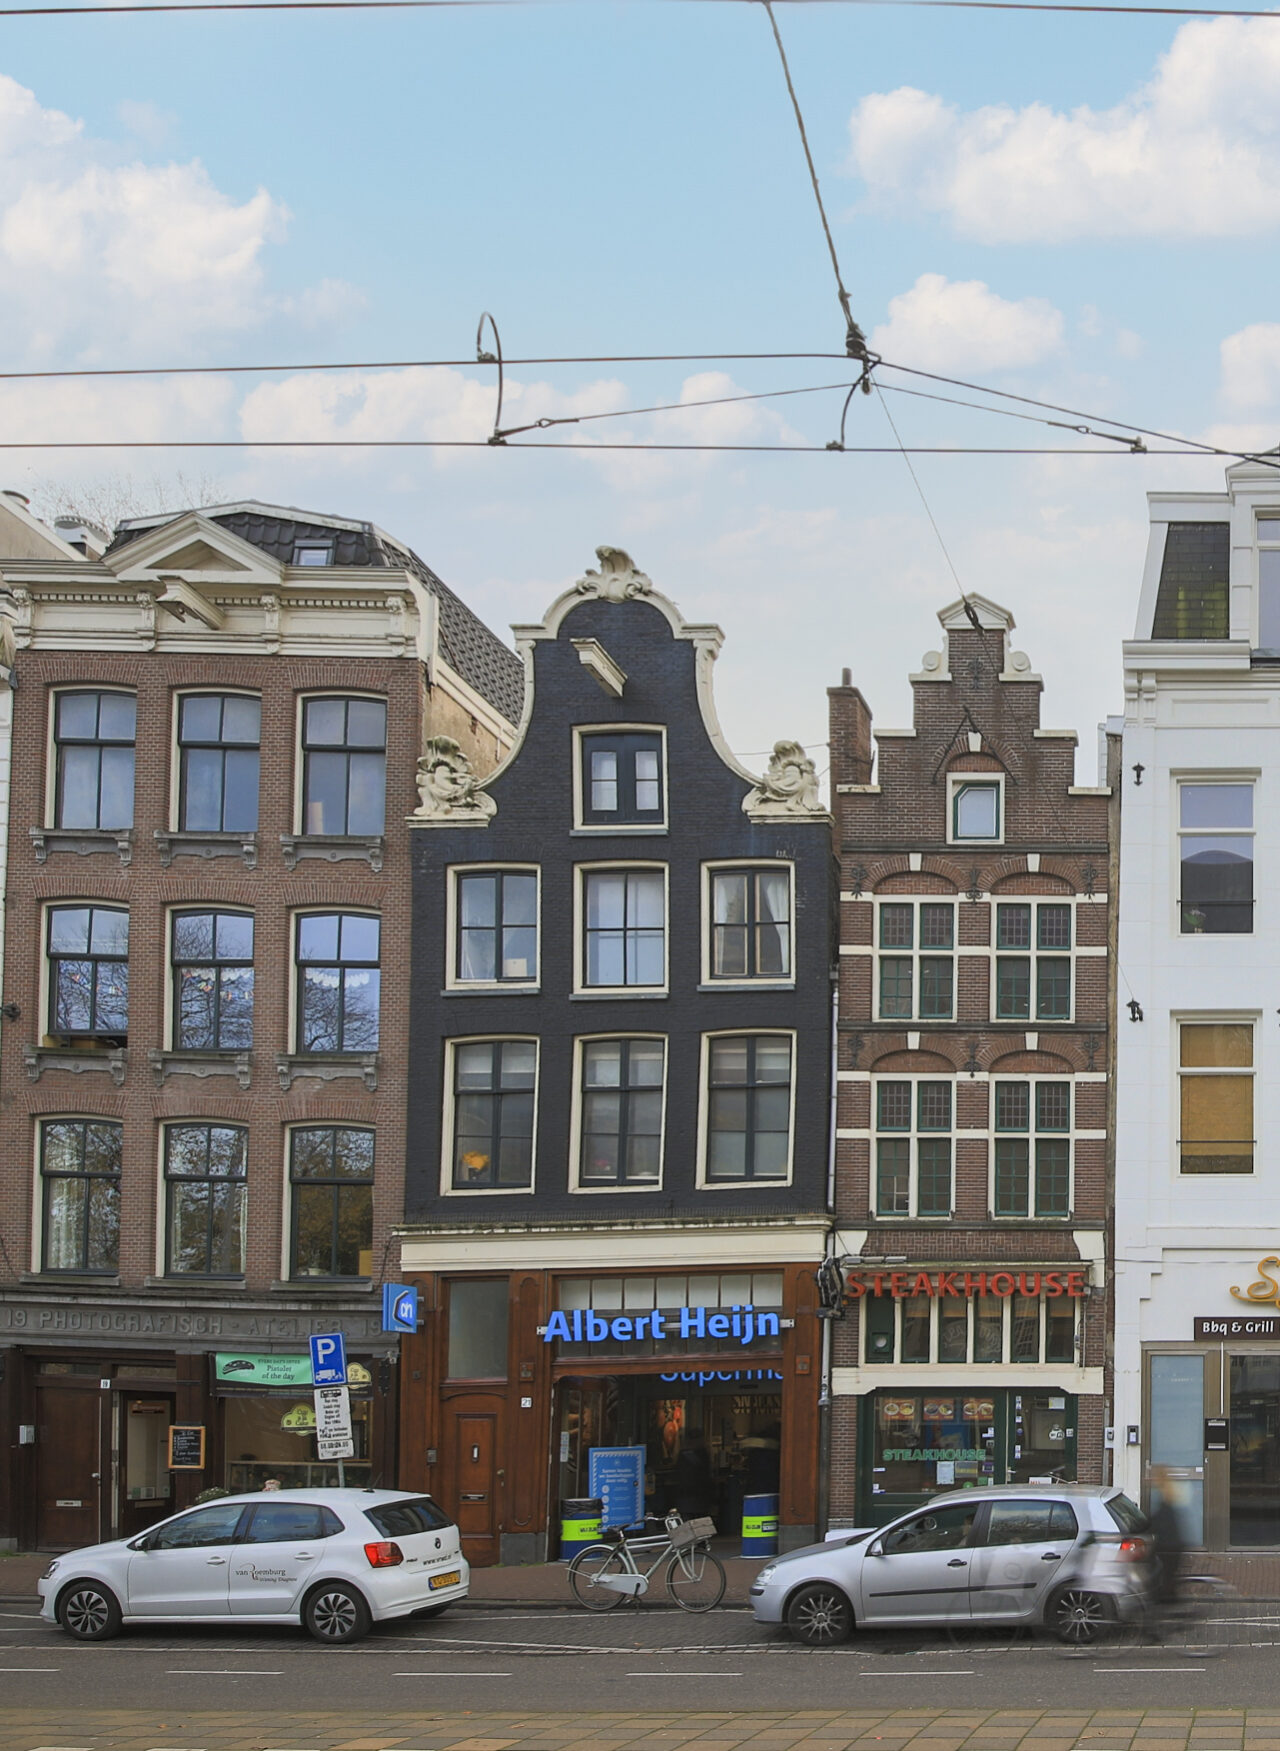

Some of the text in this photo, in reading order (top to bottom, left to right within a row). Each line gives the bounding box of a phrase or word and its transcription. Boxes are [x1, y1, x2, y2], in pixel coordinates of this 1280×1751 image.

[846, 1272, 1085, 1297] STEAKHOUSE
[7, 1309, 27, 1327] 19
[39, 1310, 223, 1335] PHOTOGRAFISCH
[544, 1304, 780, 1345] Albert Heijn
[1202, 1322, 1228, 1335] Bbq
[1231, 1323, 1242, 1333] &
[1245, 1321, 1274, 1333] Grill
[317, 1338, 336, 1364] P
[283, 1373, 295, 1381] day
[883, 1449, 986, 1461] STEAKHOUSE
